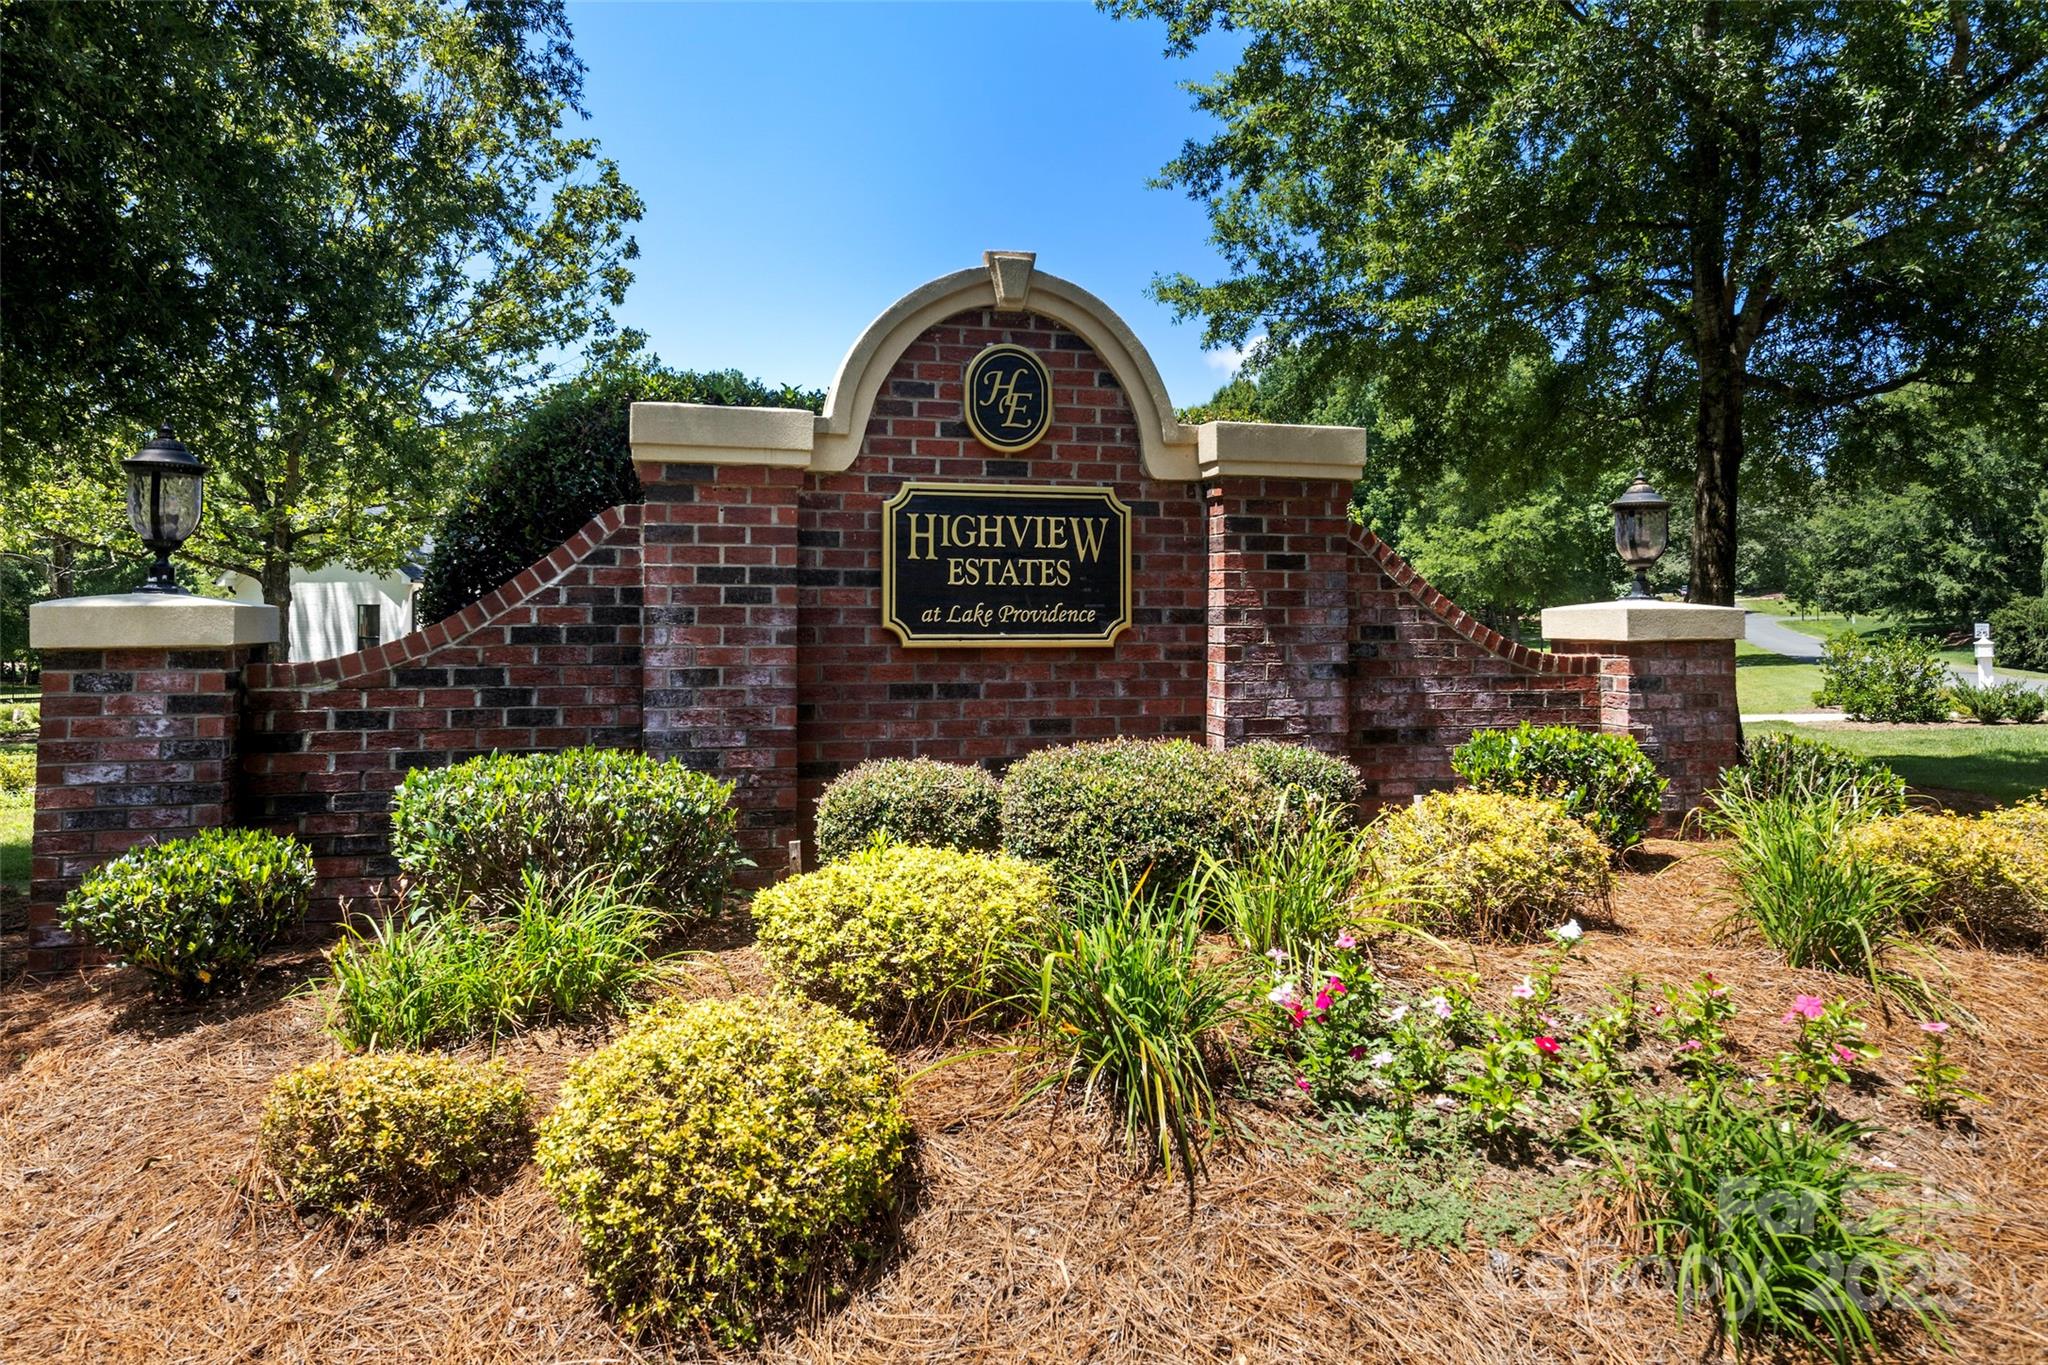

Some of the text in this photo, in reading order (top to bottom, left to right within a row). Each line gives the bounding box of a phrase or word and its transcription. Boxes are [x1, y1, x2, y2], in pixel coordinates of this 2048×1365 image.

[906, 513, 1110, 563] HIGHVIEW
[947, 557, 1071, 587] ESTATES
[921, 602, 1096, 627] at Lake Providence
